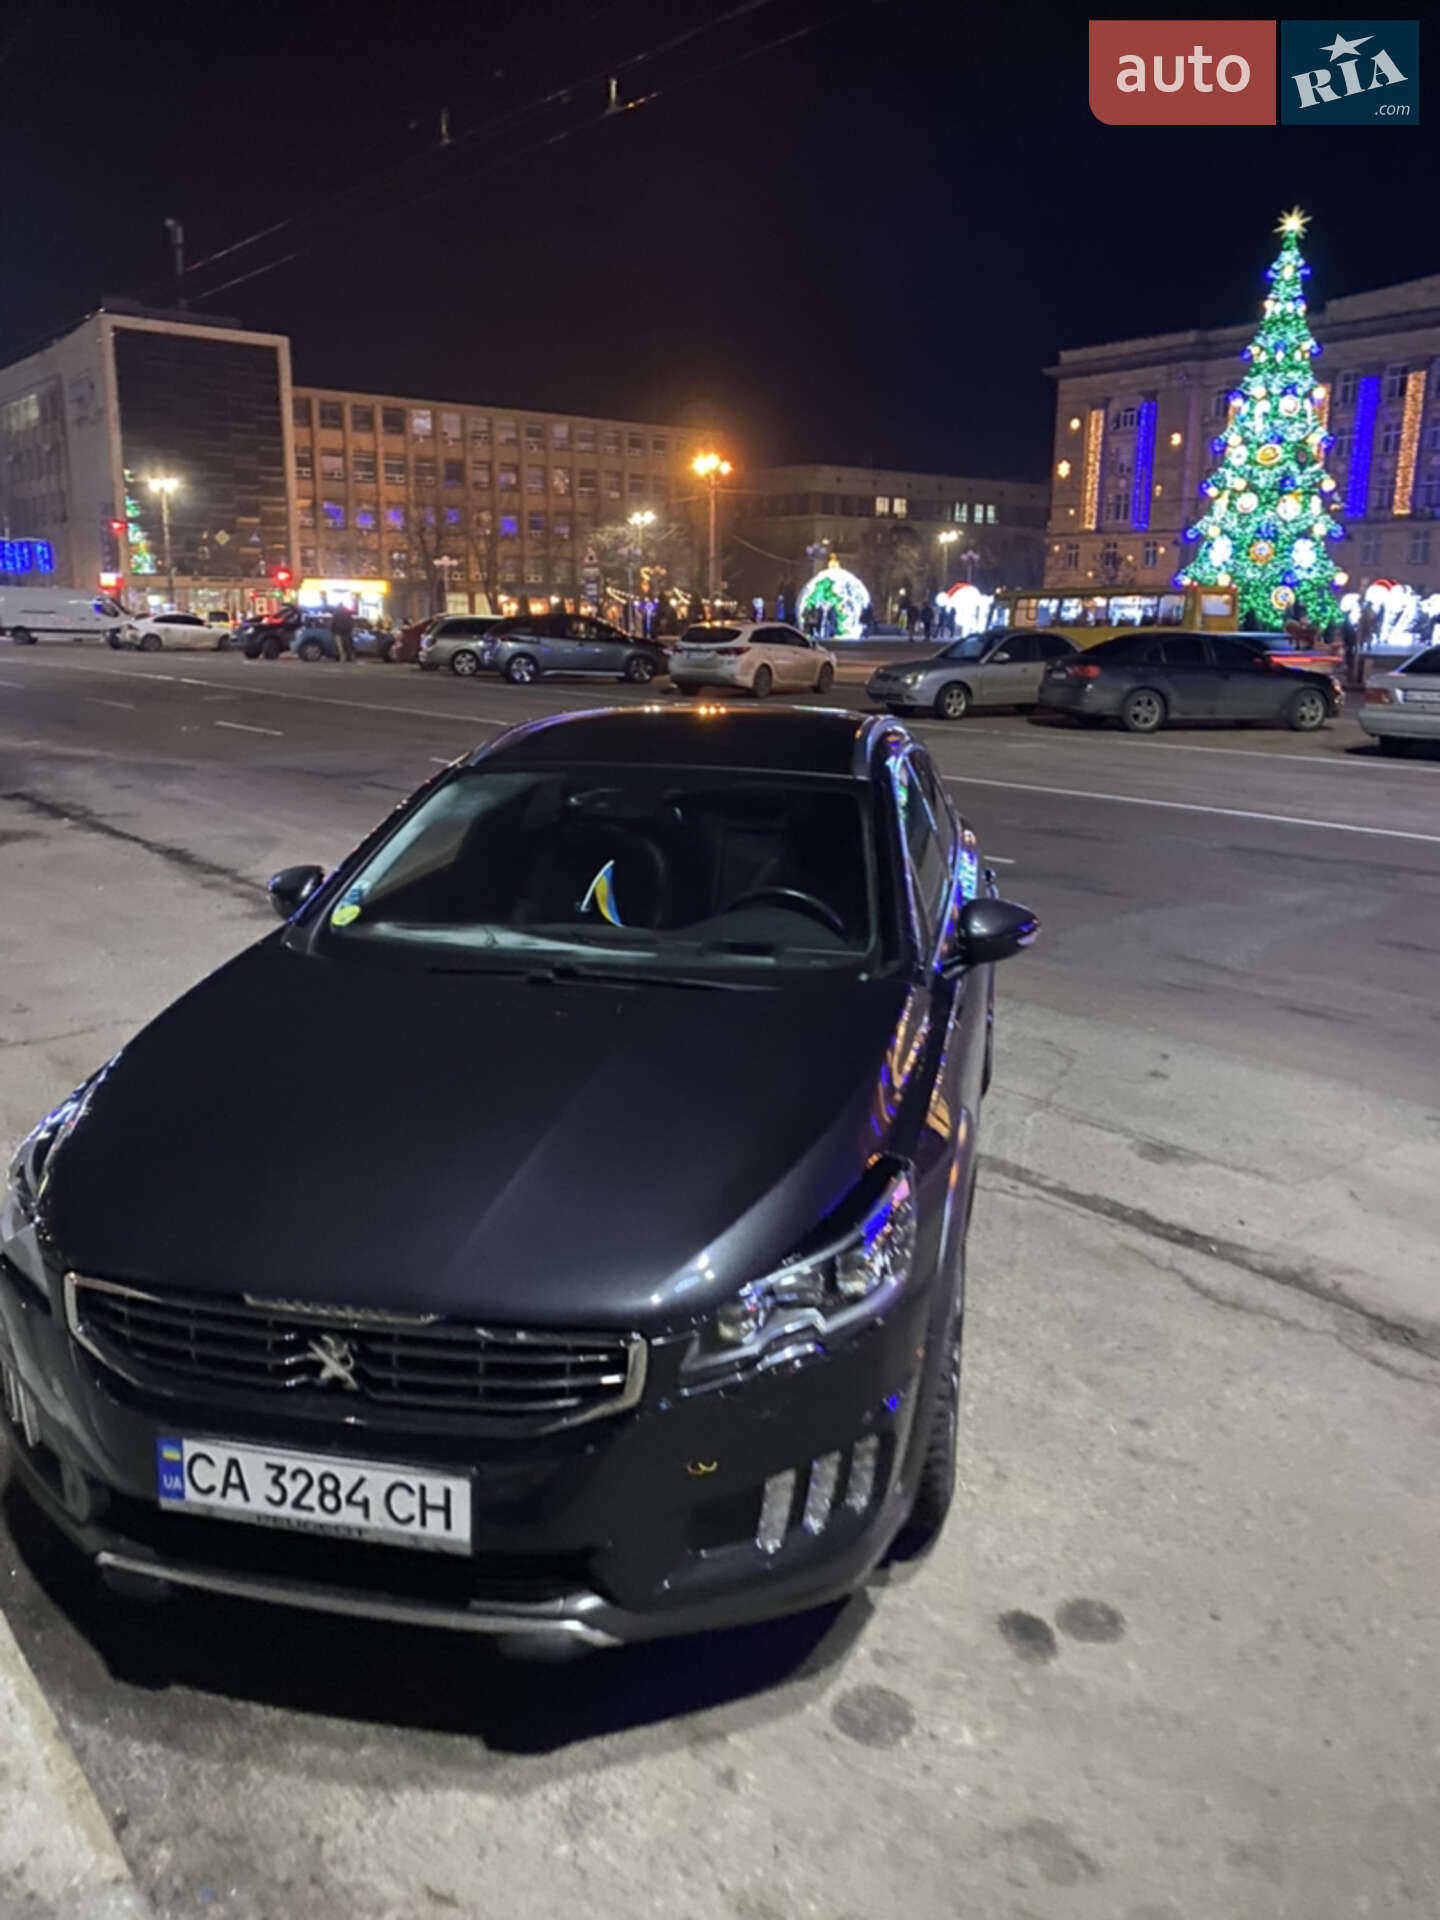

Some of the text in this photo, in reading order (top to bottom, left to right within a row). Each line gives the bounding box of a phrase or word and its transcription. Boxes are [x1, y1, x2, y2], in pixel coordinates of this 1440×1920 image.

[163, 1474, 182, 1490] UA
[186, 1452, 250, 1503] CA
[264, 1462, 371, 1520] 3284
[383, 1481, 452, 1531] CH
